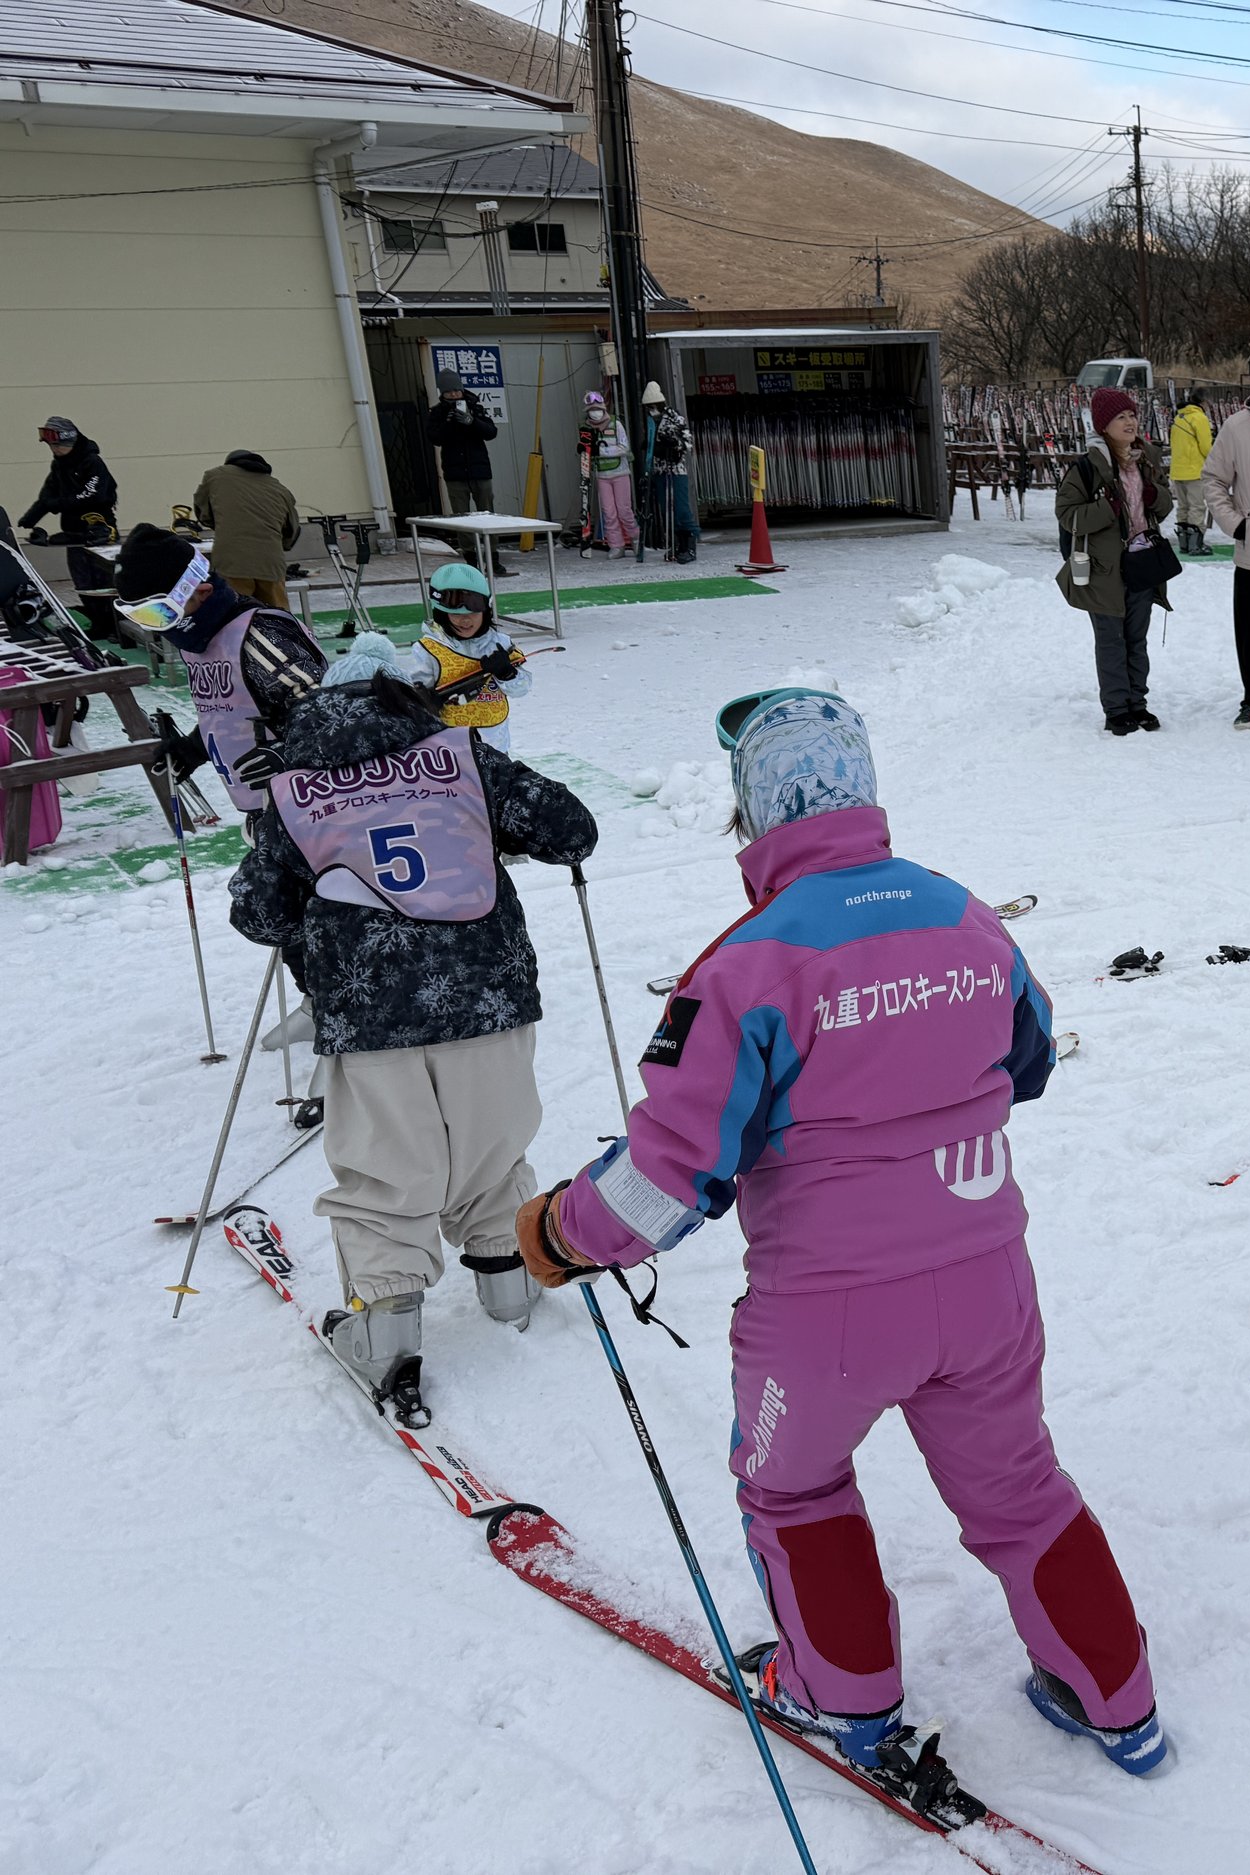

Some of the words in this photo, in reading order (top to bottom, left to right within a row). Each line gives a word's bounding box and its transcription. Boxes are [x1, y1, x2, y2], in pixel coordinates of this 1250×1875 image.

[436, 349, 497, 374] 調整台
[207, 731, 235, 787] 4
[289, 746, 461, 808] KUJYU
[309, 788, 458, 824] 九重プロスキースクール
[365, 820, 430, 895] 5
[845, 888, 912, 906] northrange
[813, 963, 1006, 1036] 九重プロスキースクール
[243, 1228, 294, 1280] EAD
[626, 1399, 653, 1453] SINANO
[455, 1477, 483, 1504] HEAD
